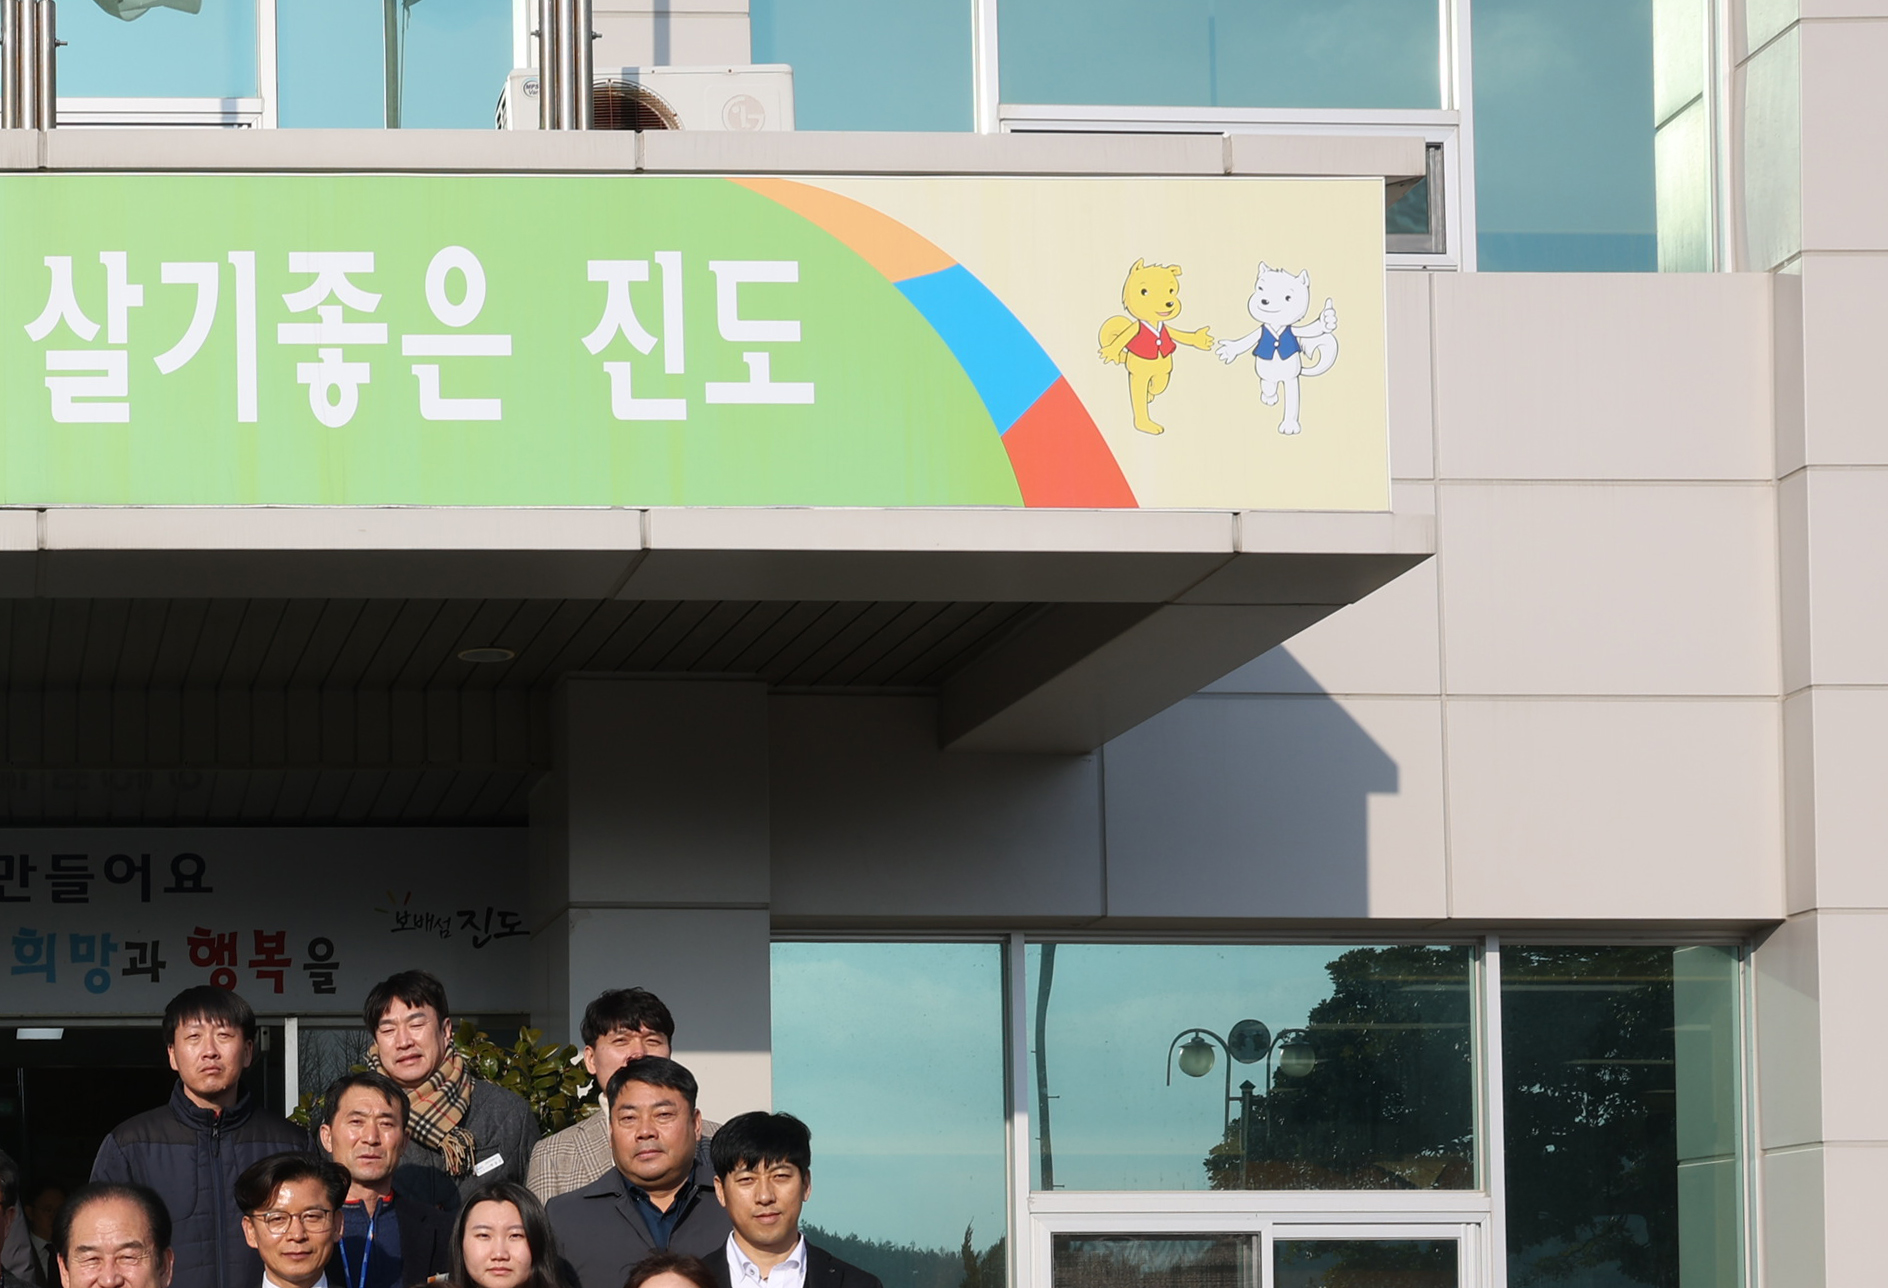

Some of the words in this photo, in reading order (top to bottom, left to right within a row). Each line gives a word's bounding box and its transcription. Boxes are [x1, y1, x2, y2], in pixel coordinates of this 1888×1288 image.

[23, 245, 512, 428] 살기좋은
[581, 250, 815, 421] 진도
[10, 926, 167, 995] 희망과
[185, 925, 340, 995] 행복을
[390, 908, 452, 940] 보배섬
[456, 905, 532, 949] 진도
